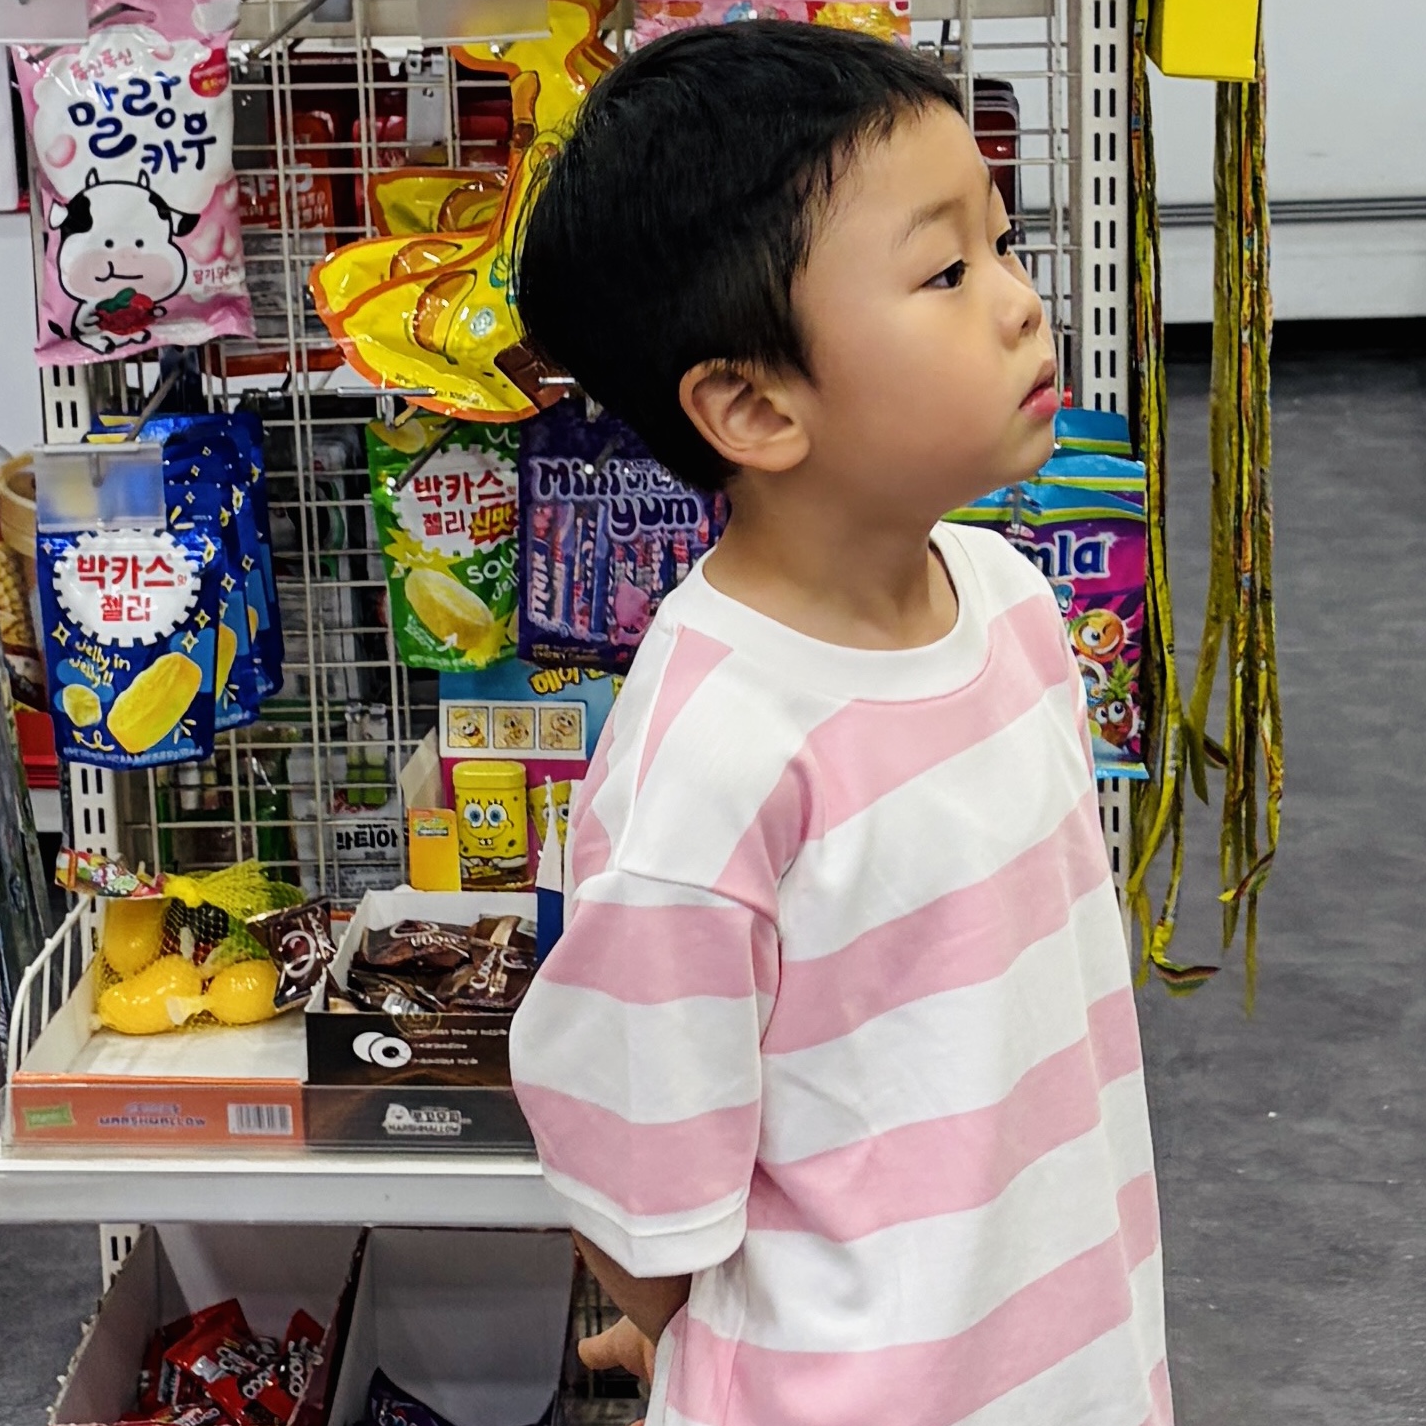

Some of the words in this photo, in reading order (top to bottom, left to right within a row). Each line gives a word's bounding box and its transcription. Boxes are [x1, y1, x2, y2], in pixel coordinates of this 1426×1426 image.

[67, 71, 181, 160] 말랑
[140, 111, 217, 174] 카우
[414, 469, 507, 508] 박카스
[536, 460, 622, 498] Mini
[422, 510, 466, 537] 젤리
[471, 503, 514, 538] 신맛
[608, 493, 702, 540] yum
[76, 553, 175, 591] 박카스
[466, 545, 519, 585] sou
[100, 594, 152, 622] 젤리
[98, 1115, 207, 1128] MARSHMALLOW
